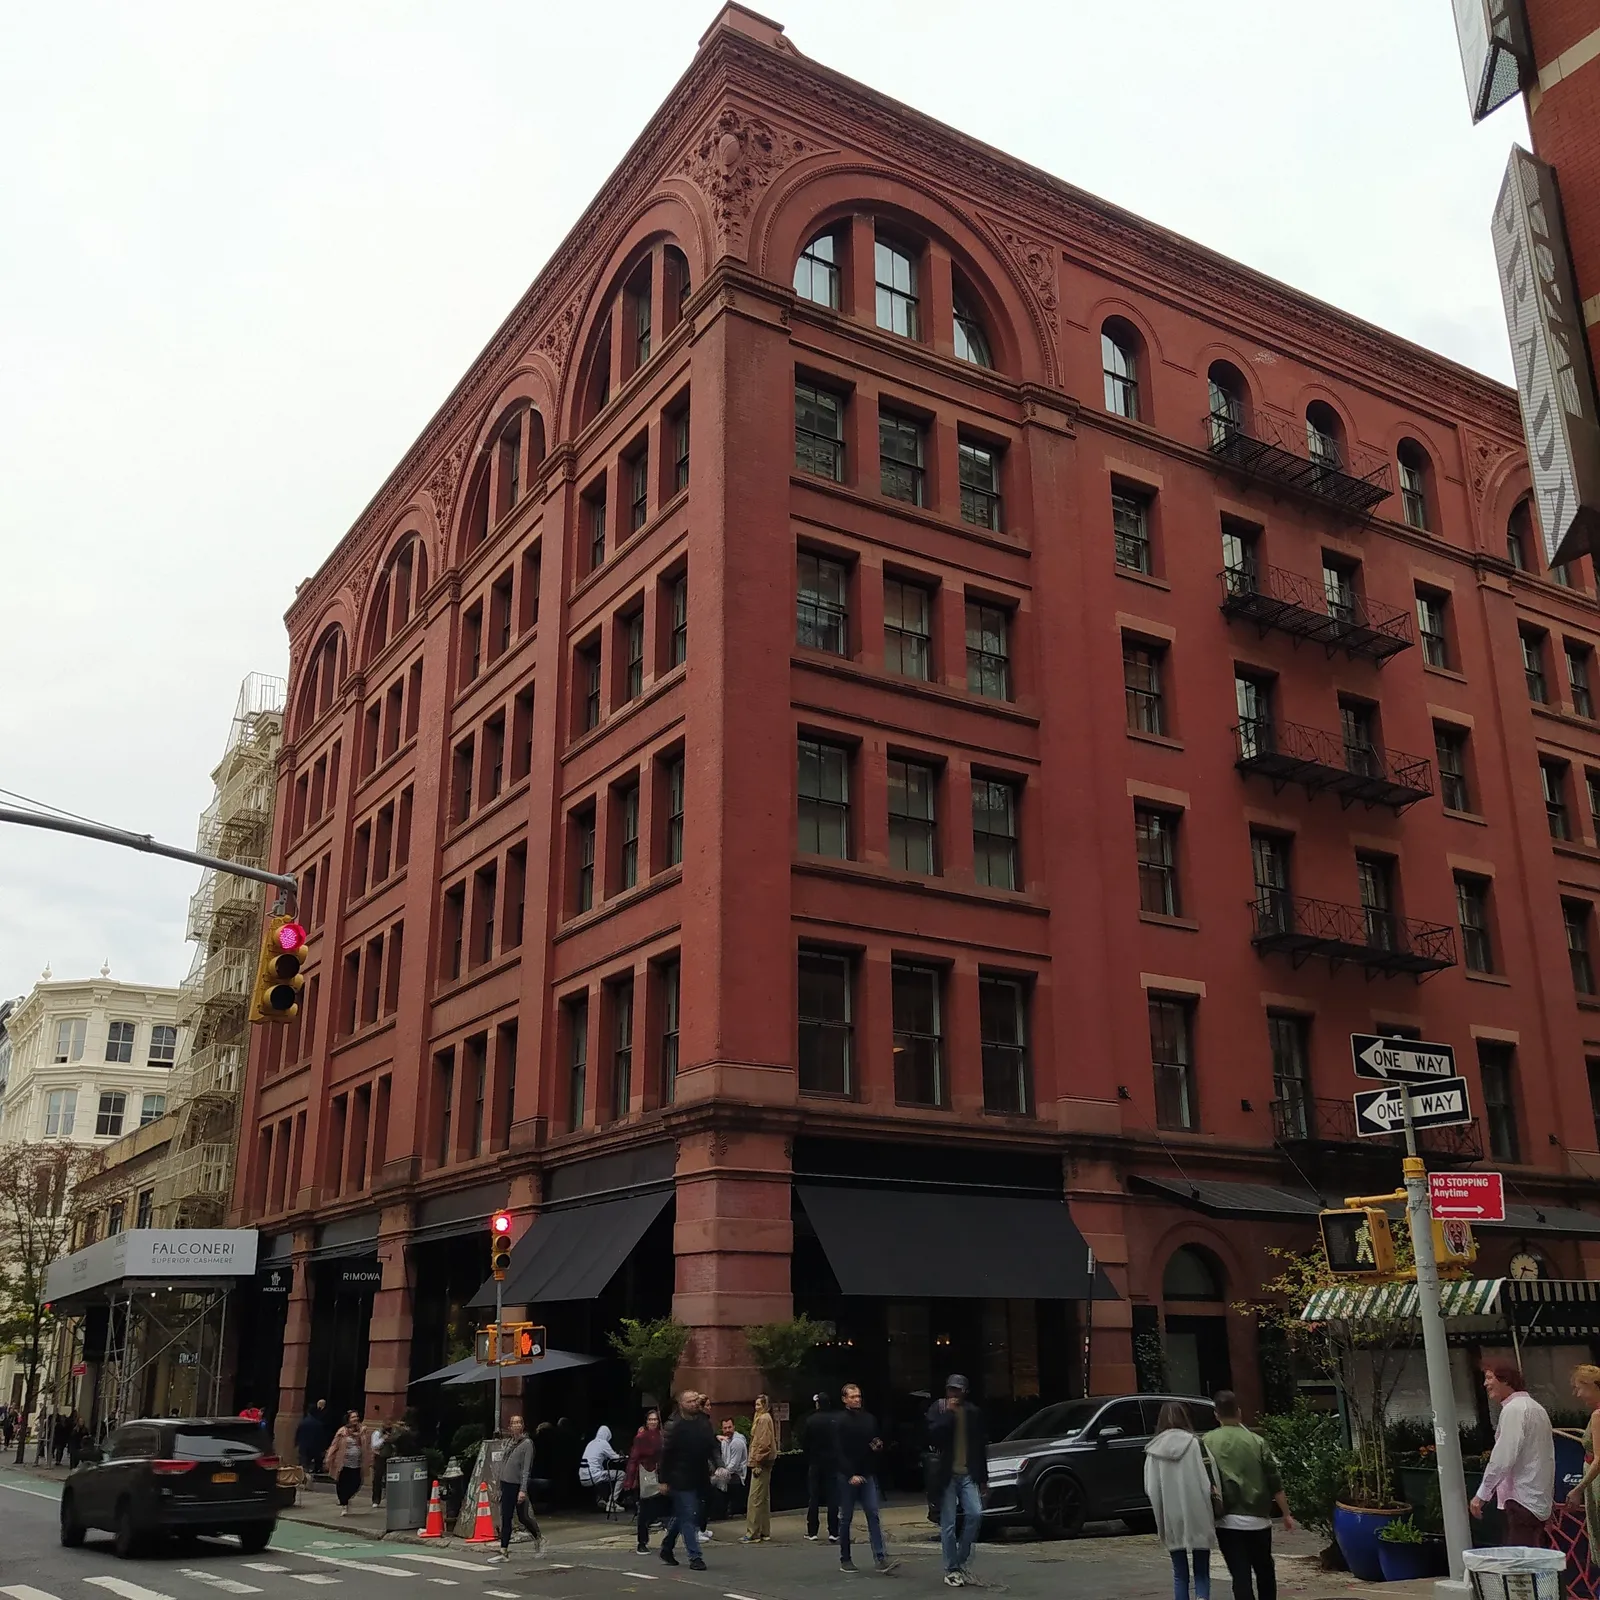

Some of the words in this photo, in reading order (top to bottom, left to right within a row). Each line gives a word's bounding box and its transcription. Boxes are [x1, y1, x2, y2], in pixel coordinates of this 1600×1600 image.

[1496, 163, 1566, 553] PRADA
[1373, 1050, 1402, 1069] ONE
[1414, 1054, 1443, 1073] WAY
[1376, 1101, 1404, 1119] ONE
[1421, 1093, 1454, 1113] WAY
[1432, 1177, 1445, 1187] NO
[1446, 1177, 1488, 1187] STOPPING
[1434, 1188, 1469, 1199] Anytime
[152, 1243, 235, 1254] FALCONERI
[342, 1272, 381, 1281] RIMOWA
